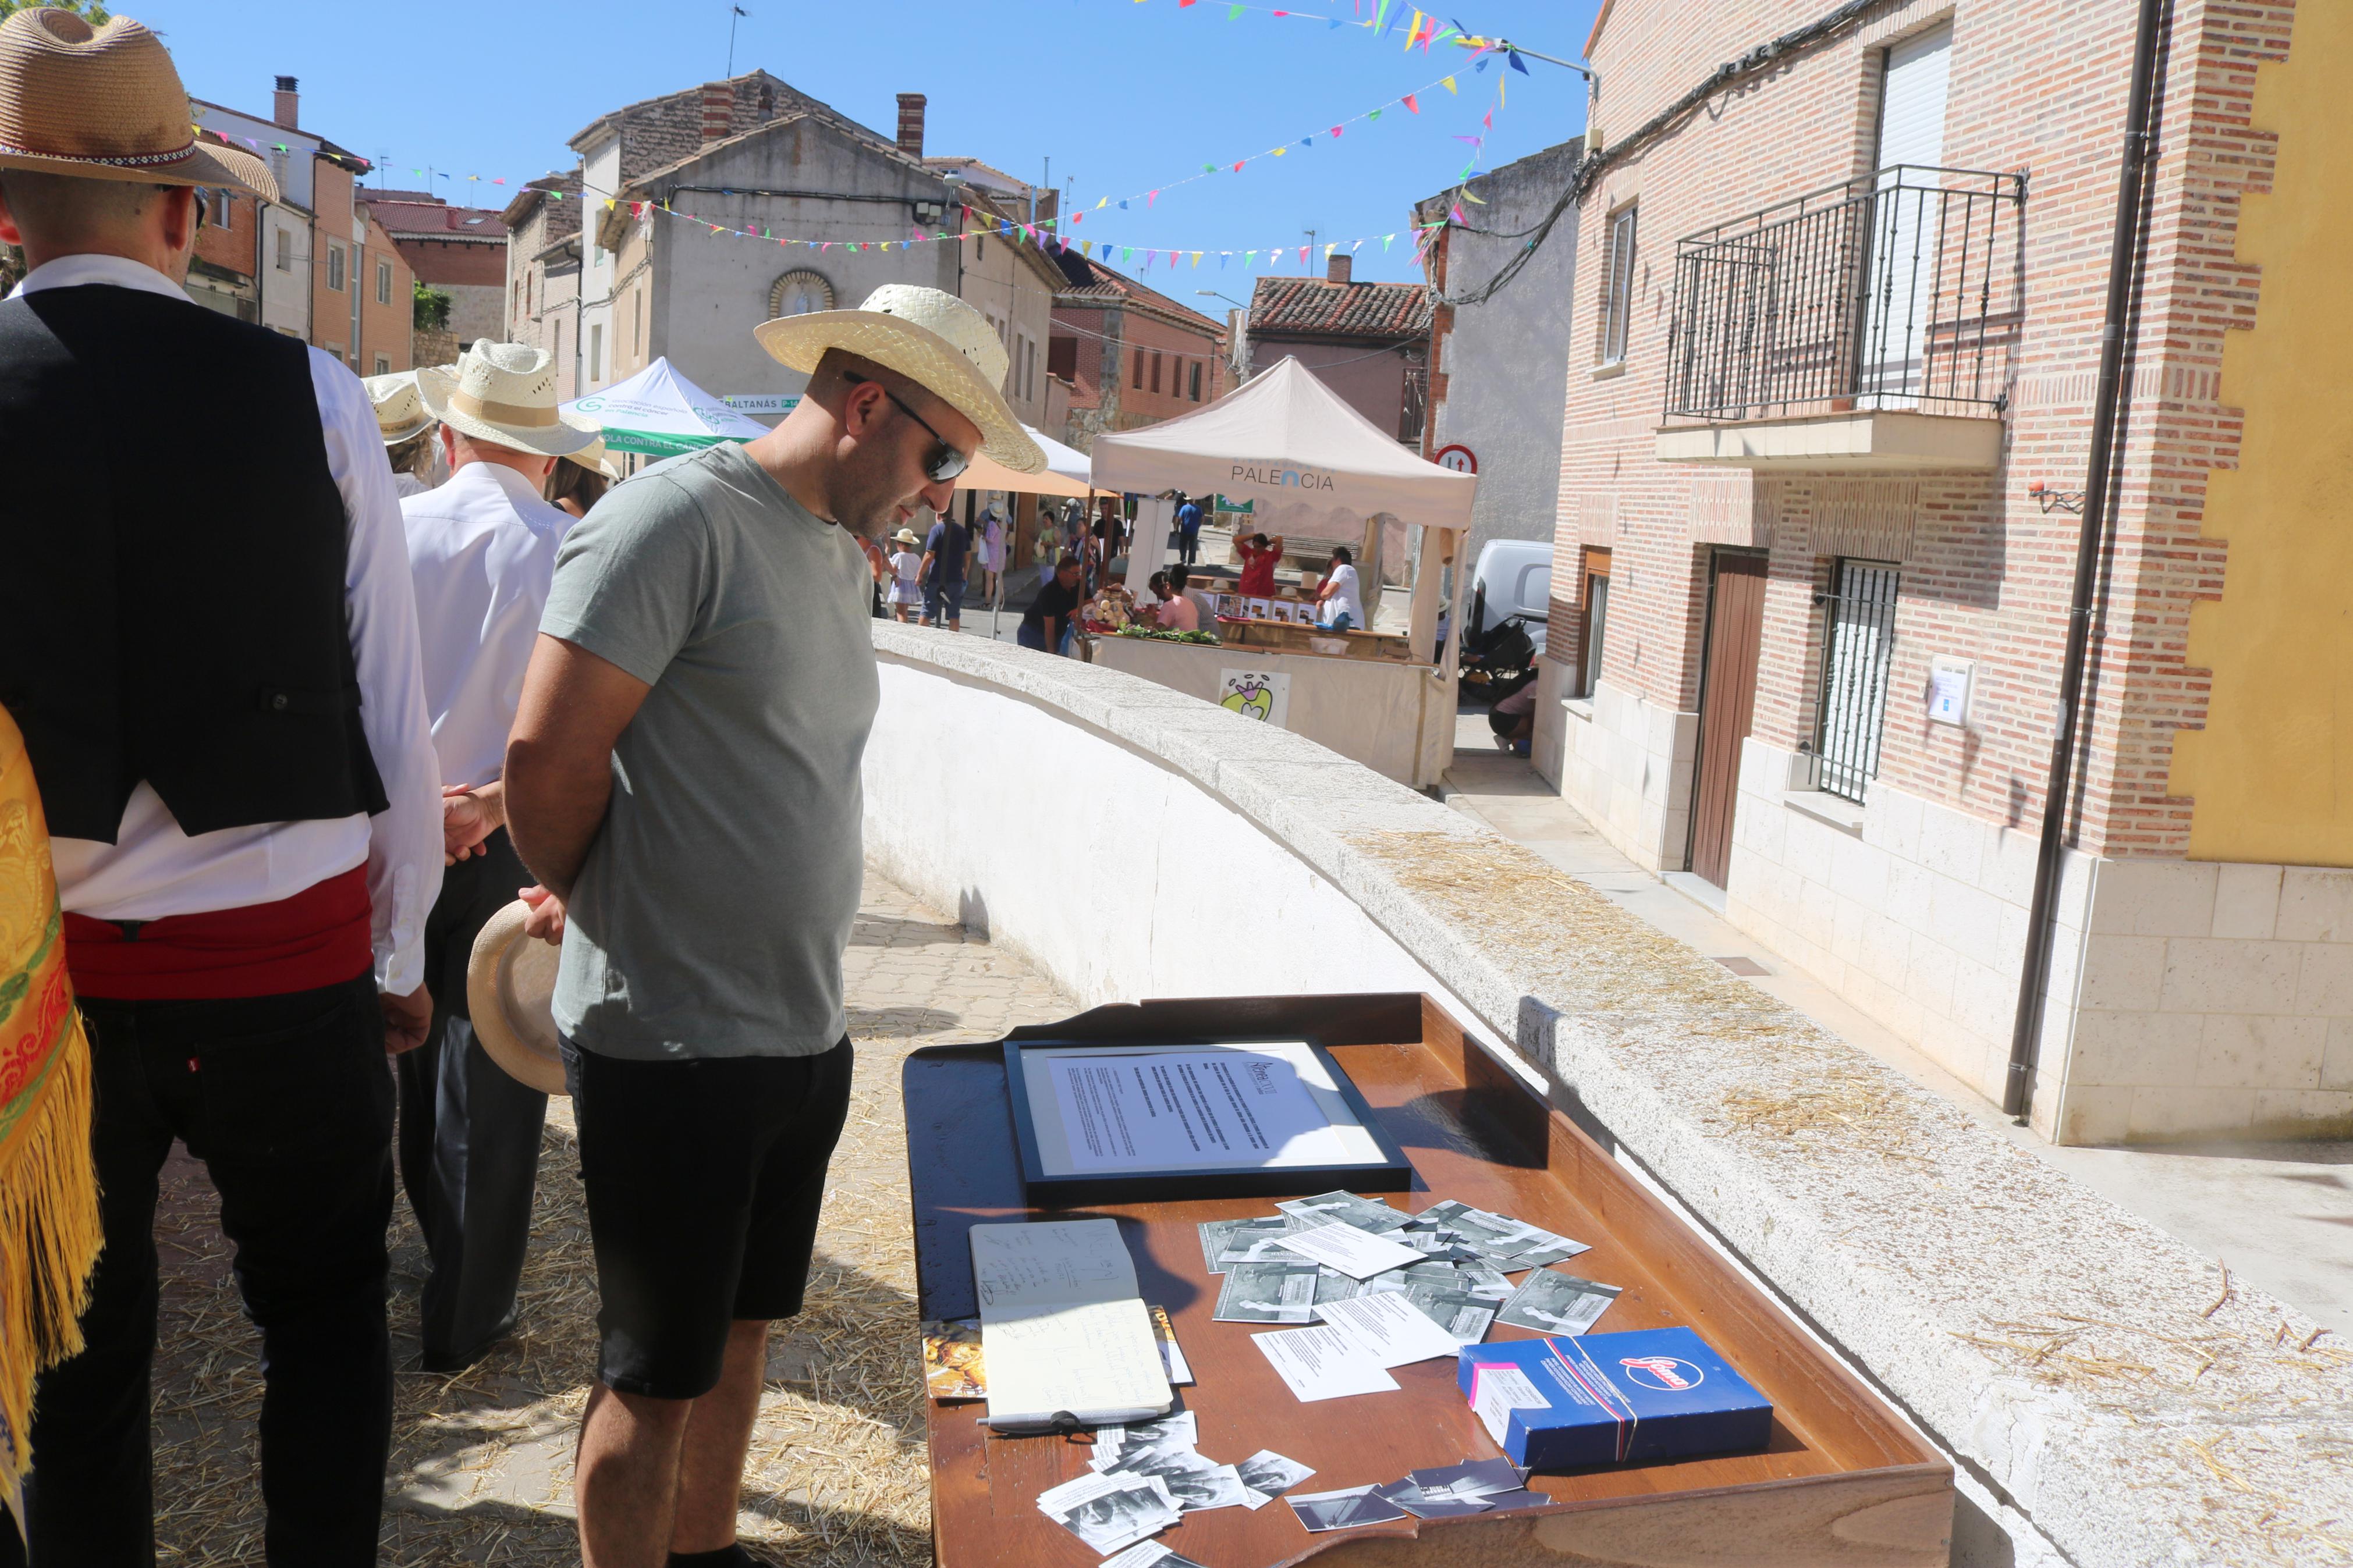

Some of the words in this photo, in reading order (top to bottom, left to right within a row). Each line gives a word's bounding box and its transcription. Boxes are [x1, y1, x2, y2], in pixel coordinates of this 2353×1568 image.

[616, 408, 648, 417] Palencia
[624, 436, 661, 447] CONTRA
[663, 441, 673, 449] EL
